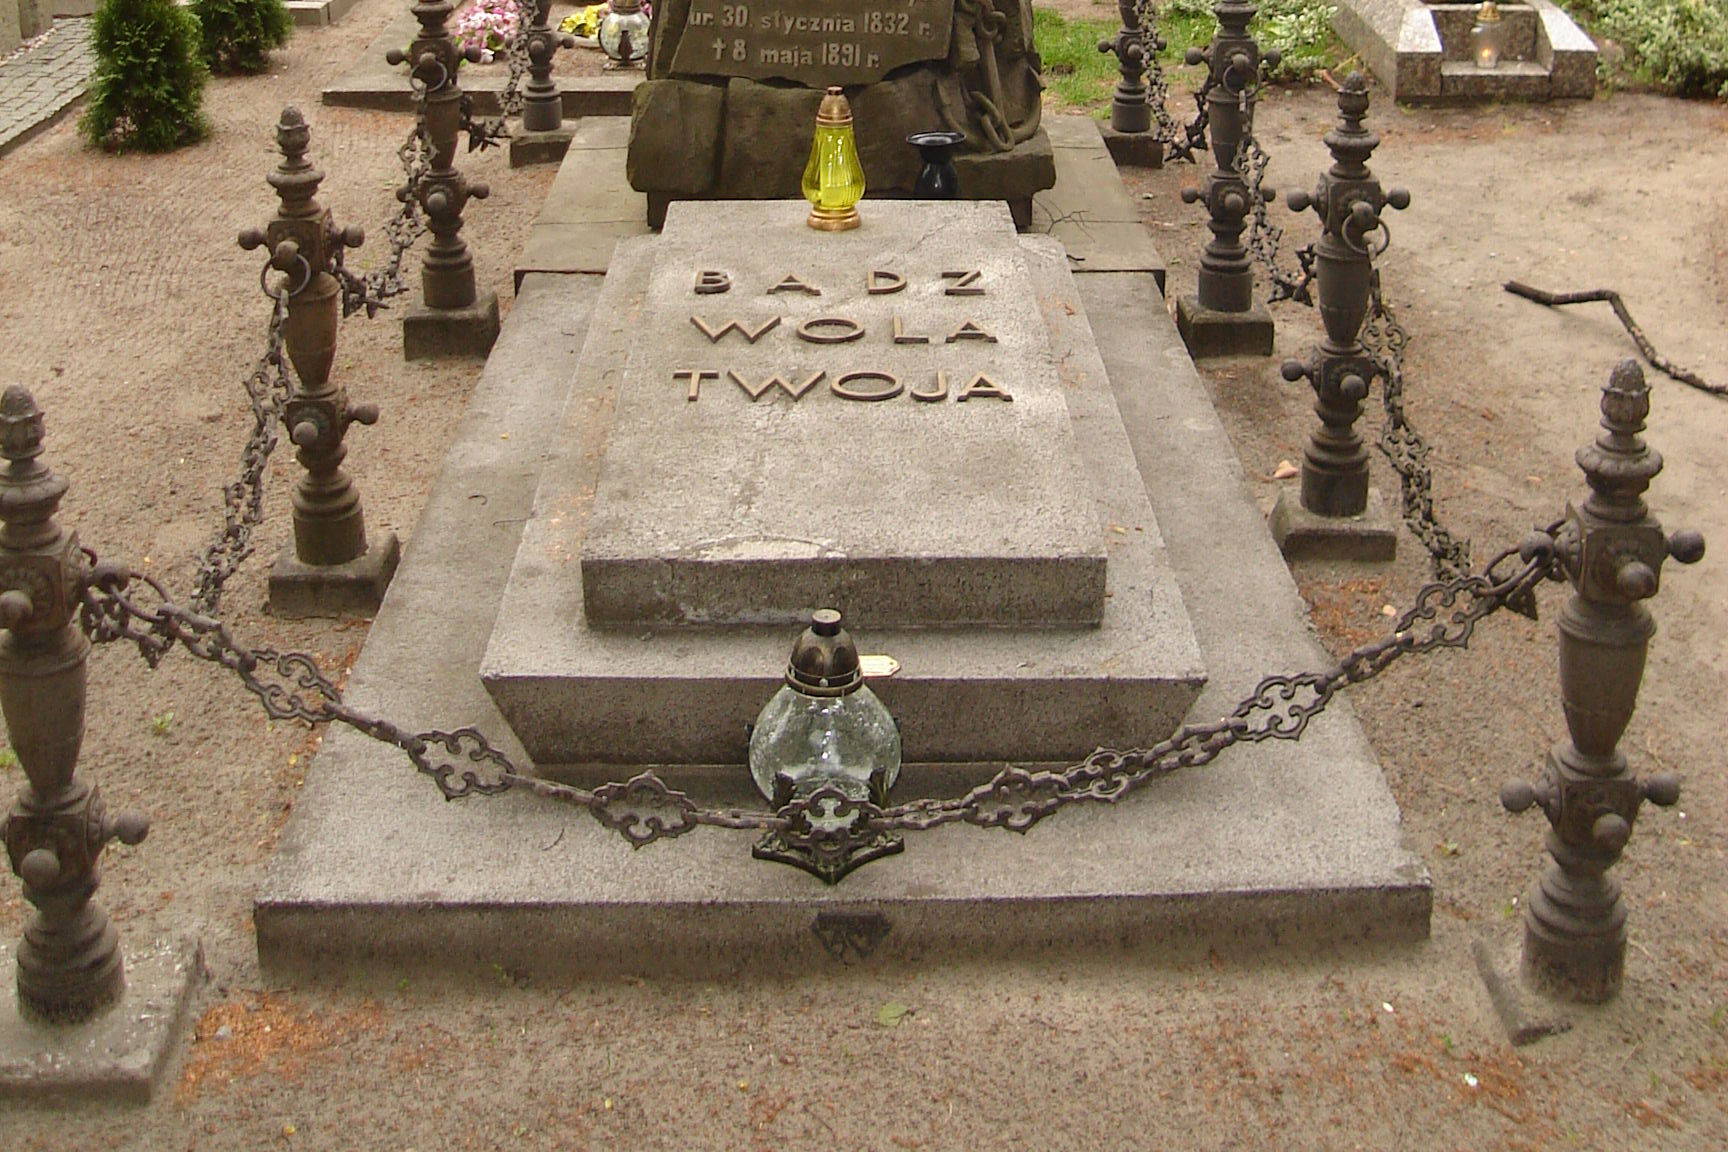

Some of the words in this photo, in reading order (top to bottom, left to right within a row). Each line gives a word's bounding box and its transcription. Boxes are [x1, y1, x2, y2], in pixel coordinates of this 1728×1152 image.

[689, 11, 714, 28] ur.
[721, 4, 752, 29] 30.
[760, 10, 856, 38] stycznia
[863, 11, 910, 35] 1832
[917, 20, 933, 38] r.
[760, 45, 813, 68] maja
[821, 41, 862, 67] 1891
[866, 51, 880, 69] r.
[689, 314, 998, 345] WOLA
[672, 369, 1014, 402] TWOJA
